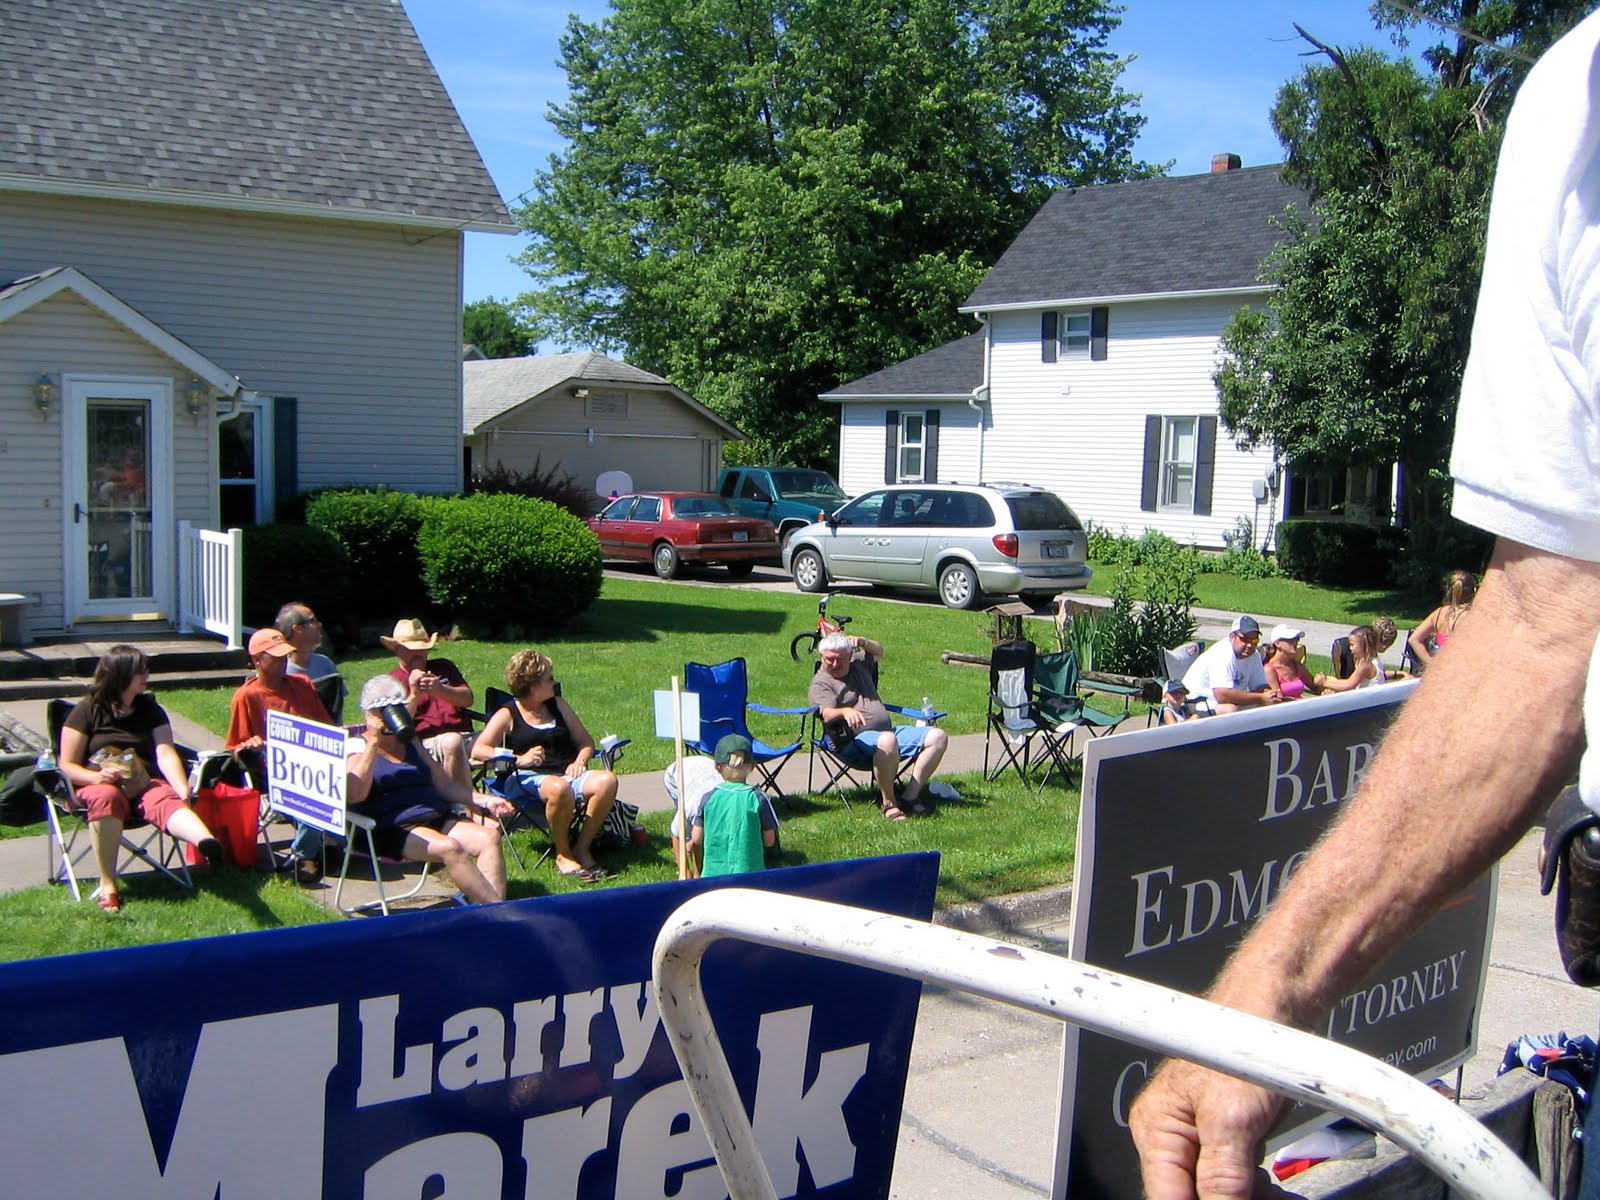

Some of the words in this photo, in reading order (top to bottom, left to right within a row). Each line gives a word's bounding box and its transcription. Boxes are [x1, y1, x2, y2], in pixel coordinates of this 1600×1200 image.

[270, 723, 301, 743] COUNTY
[304, 731, 345, 756] ATTORNEY
[271, 746, 342, 801] Brock
[356, 979, 661, 1108] Larry
[0, 1003, 870, 1200] Marek
